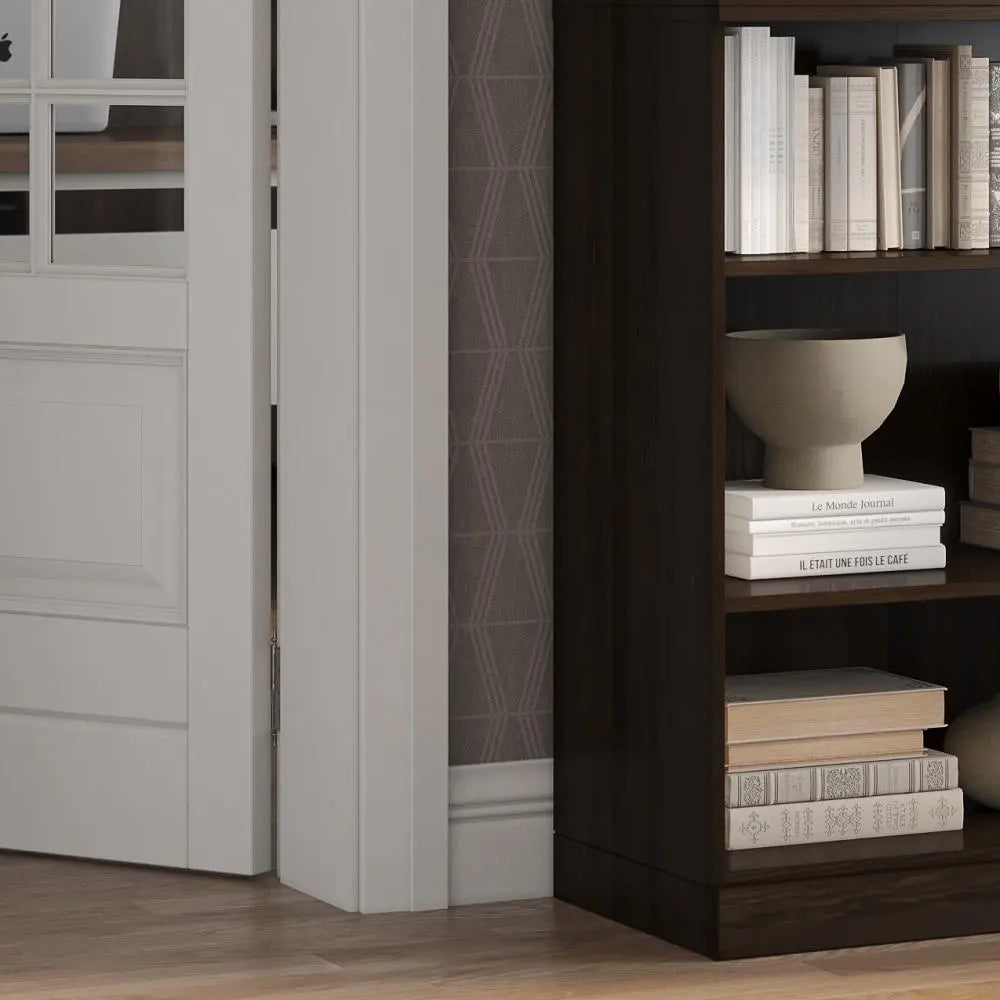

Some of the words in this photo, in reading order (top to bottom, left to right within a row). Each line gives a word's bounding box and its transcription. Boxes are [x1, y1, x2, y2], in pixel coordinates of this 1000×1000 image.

[812, 502, 823, 511] Le
[826, 500, 858, 511] Monde
[860, 498, 895, 510] Journal
[799, 560, 807, 571] IL
[835, 557, 852, 569] UNE
[854, 556, 873, 568] FOIS
[875, 555, 885, 566] LE
